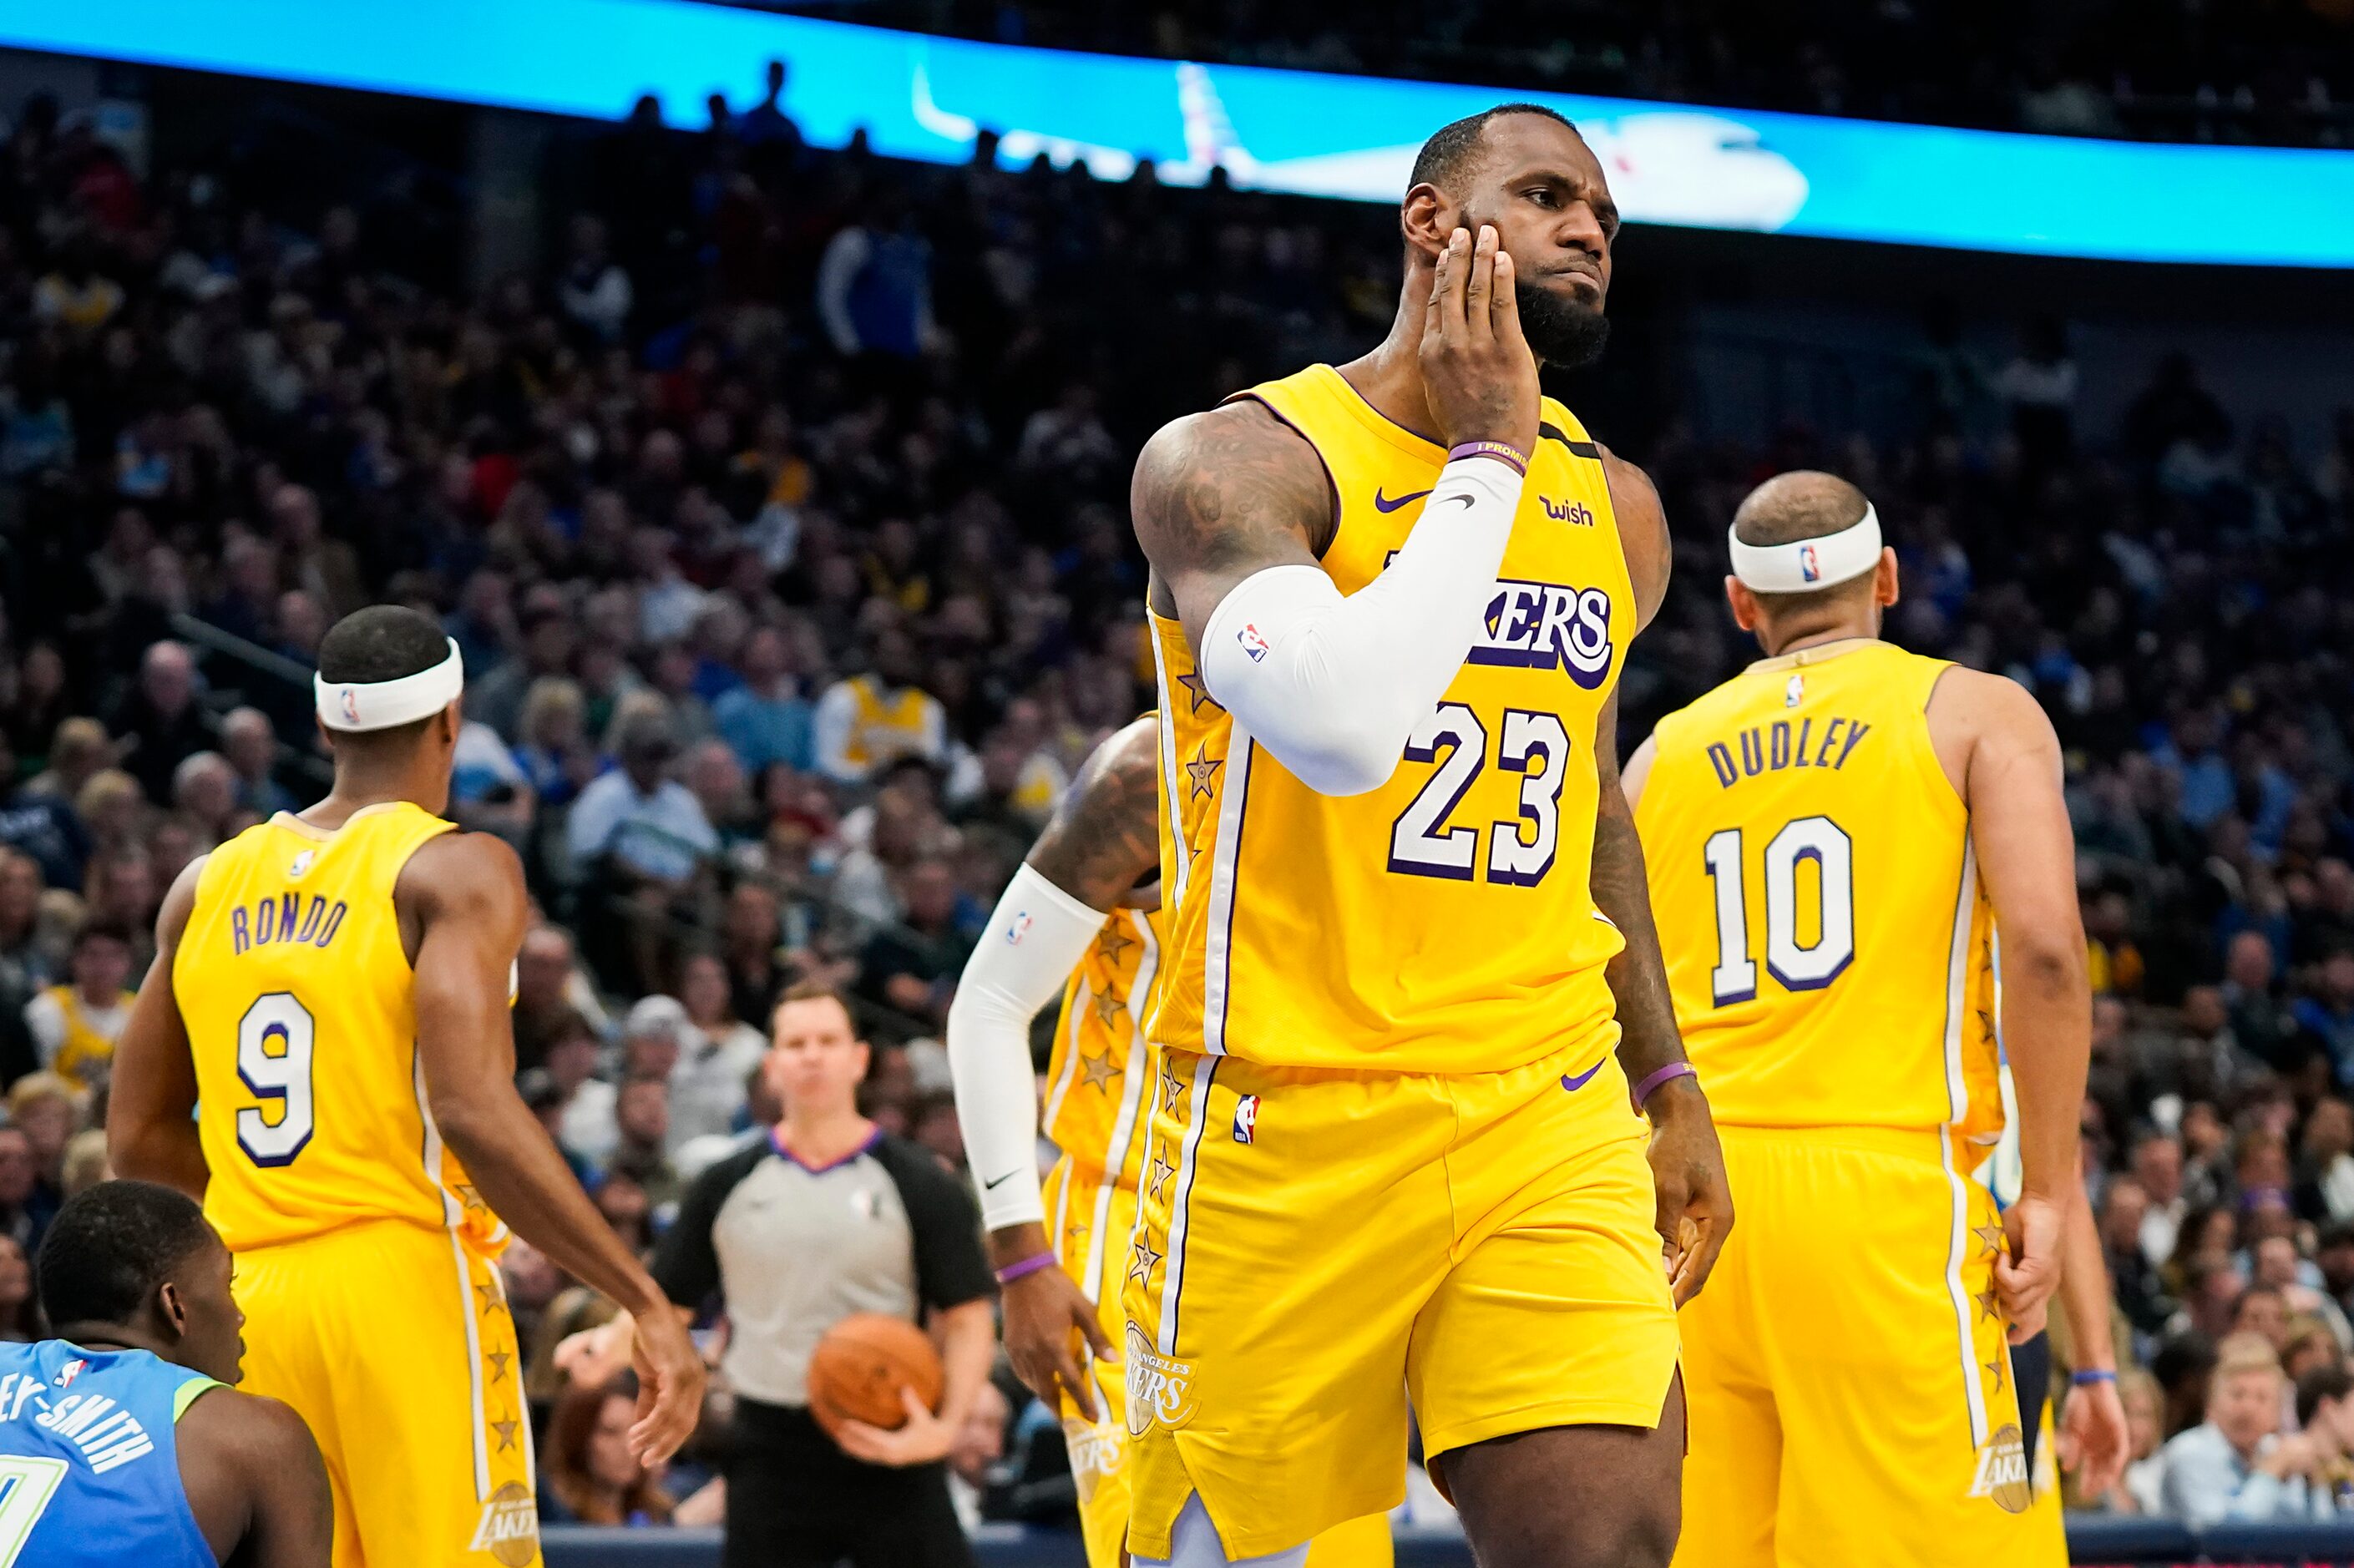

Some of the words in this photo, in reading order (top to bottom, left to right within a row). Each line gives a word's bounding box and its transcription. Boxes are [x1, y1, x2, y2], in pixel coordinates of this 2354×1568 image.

[1477, 443, 1483, 452] I
[1484, 443, 1528, 467] PROMIS
[1538, 494, 1593, 527] wish
[1706, 717, 1871, 789] DUDLEY
[1386, 701, 1571, 888] 23
[230, 891, 348, 955] RONDO
[1703, 814, 1855, 1009] 10
[235, 990, 314, 1169] 9
